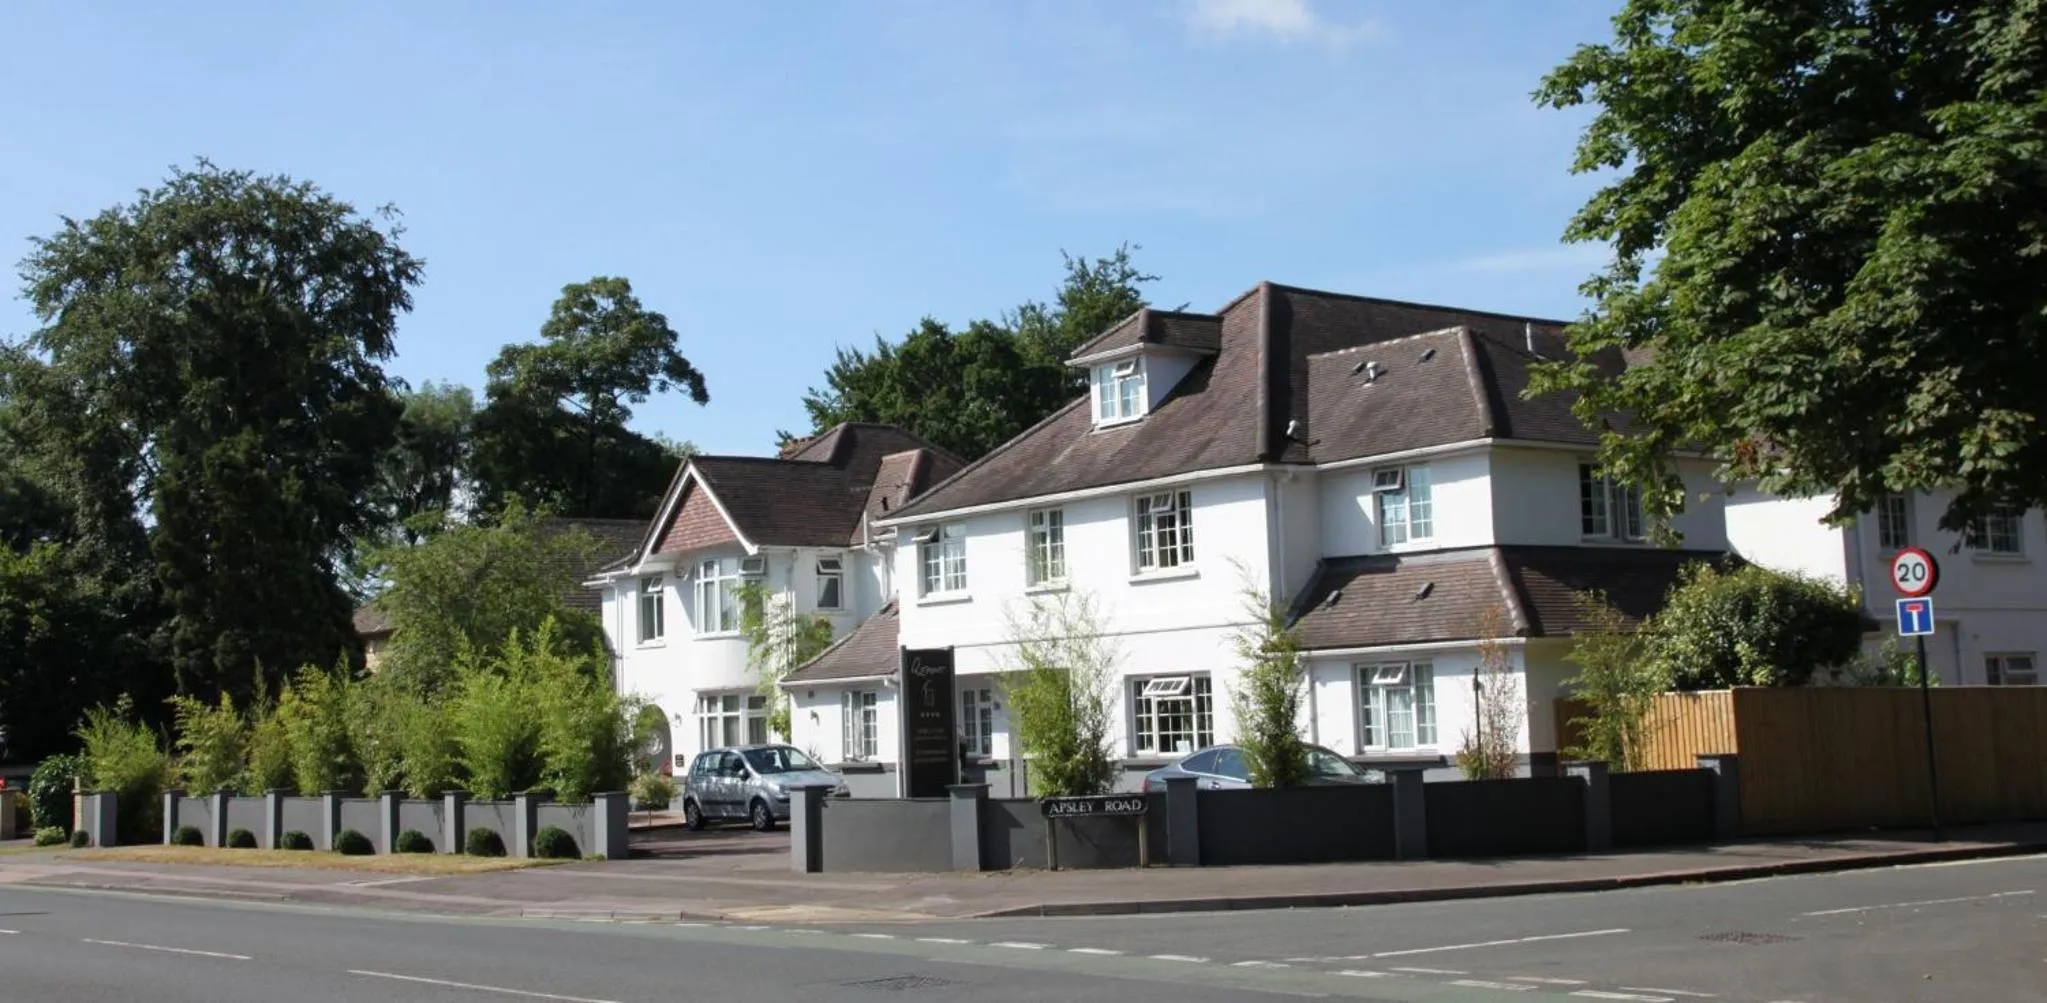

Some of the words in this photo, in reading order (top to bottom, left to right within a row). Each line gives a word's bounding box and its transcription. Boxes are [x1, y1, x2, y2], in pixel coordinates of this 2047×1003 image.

[1898, 563, 1926, 582] 20
[1050, 802, 1094, 814] APSLEY
[1105, 799, 1142, 812] ROAD
